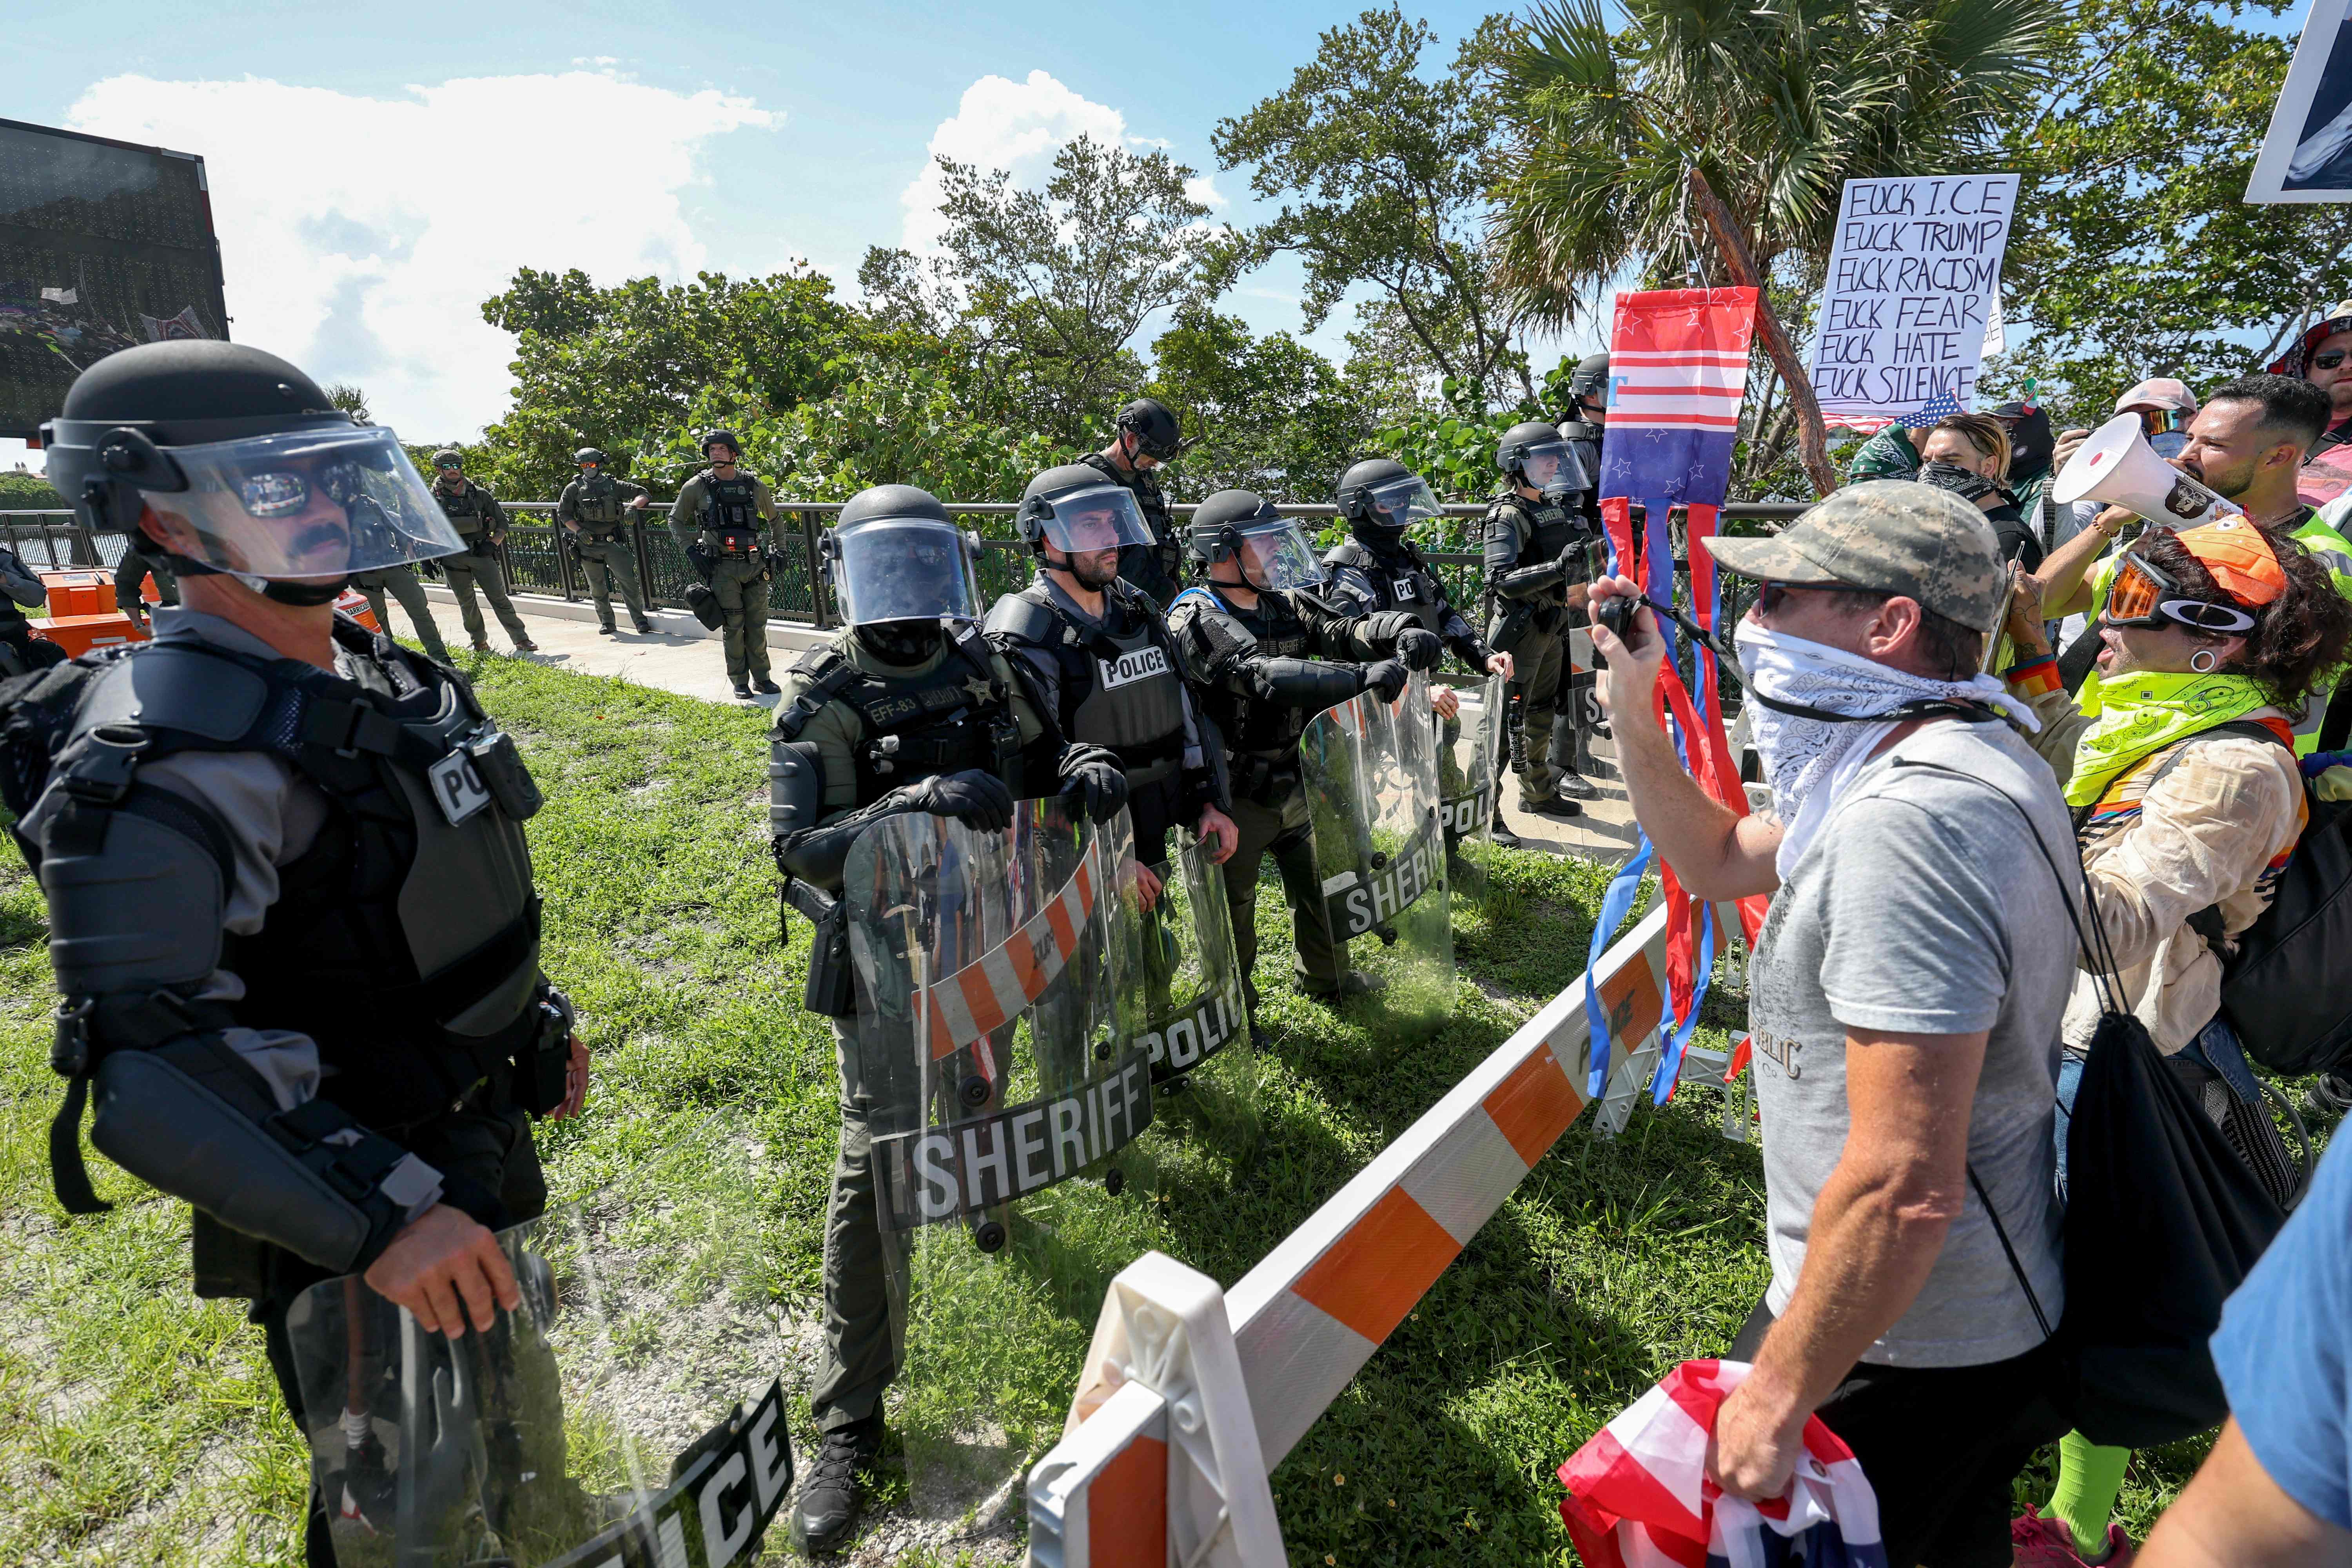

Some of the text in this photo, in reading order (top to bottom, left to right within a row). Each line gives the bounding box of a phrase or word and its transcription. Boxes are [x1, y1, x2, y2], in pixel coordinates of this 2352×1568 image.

[1848, 181, 2007, 217] FUCK I.C.E
[1843, 220, 2003, 254] FUCK TRUMP
[1837, 257, 1995, 294] FUCK RACISM
[1828, 298, 1886, 331] FUCK
[1896, 295, 1983, 328] FEAR
[1819, 331, 1961, 364] FUCK HATE
[1811, 366, 1974, 405] FUCK SILENCE
[1279, 639, 1299, 654] SHERIFF
[1105, 650, 1164, 683] POLICE
[913, 1063, 1139, 1217] SHERIFF
